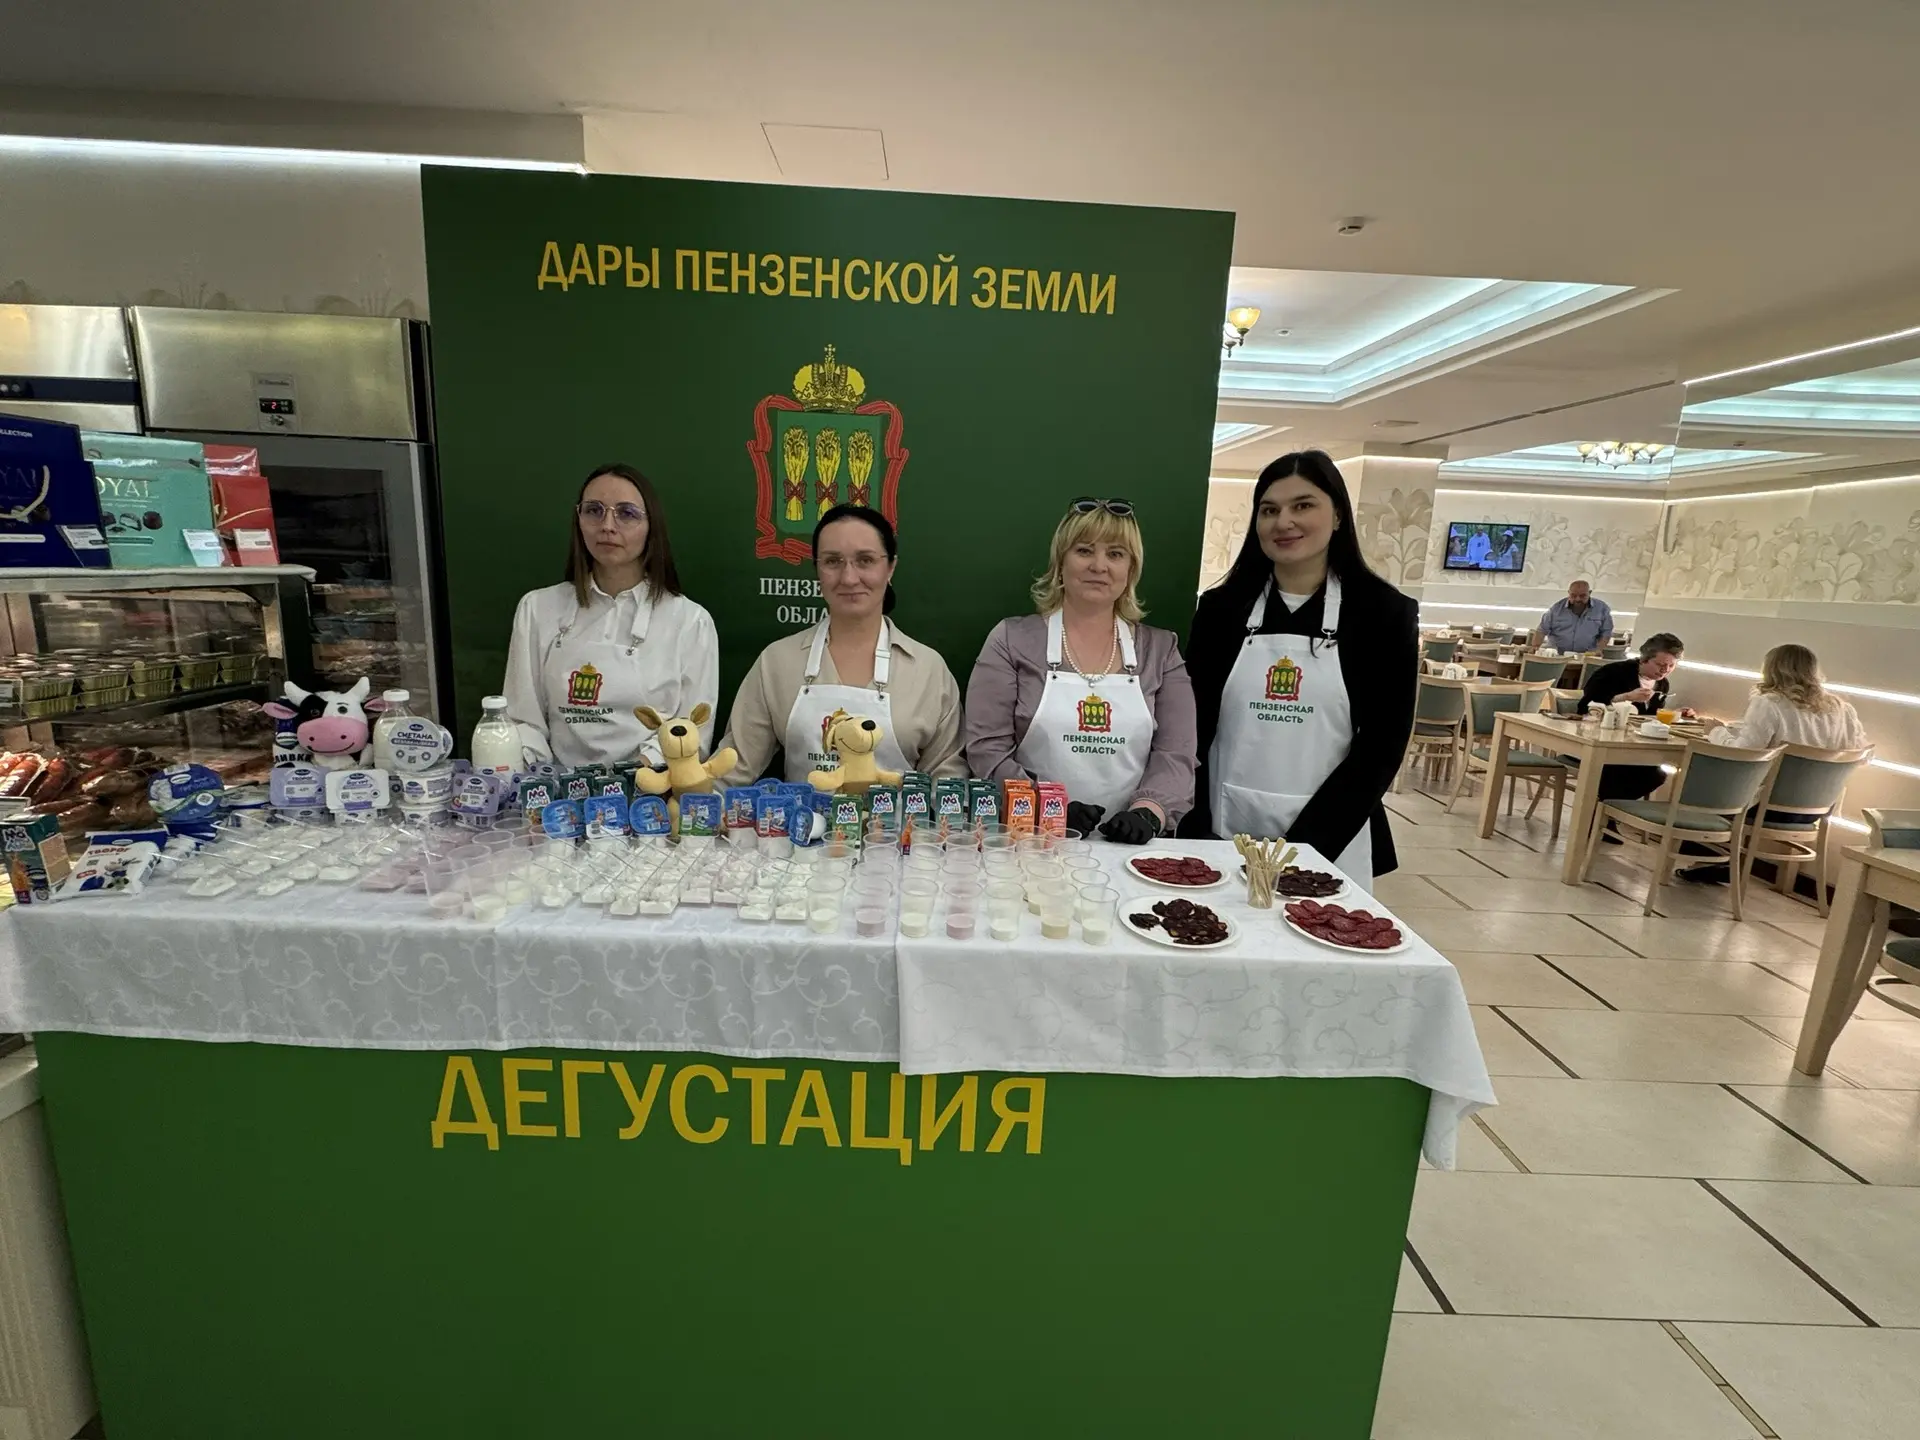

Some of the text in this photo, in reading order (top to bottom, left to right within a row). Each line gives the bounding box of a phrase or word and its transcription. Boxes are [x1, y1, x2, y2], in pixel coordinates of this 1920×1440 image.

[538, 241, 1116, 315] ДАРЫ ПЕНЗЕНСКОЙ ЗЕМЛИ
[759, 578, 823, 597] ПЕНЗЕ
[1249, 702, 1314, 713] ПЕНЗЕНСКАЯ
[1257, 713, 1304, 724] ОБЛАСТЬ
[397, 731, 433, 740] СМЕТАНА
[1063, 734, 1126, 745] ПЕНЗЕНСКАЯ
[1071, 745, 1117, 755] ОБЛАСТЬ
[275, 752, 313, 763] ЛИВКИ
[431, 1056, 1046, 1166] ДЕГУСТАЦИЯ
